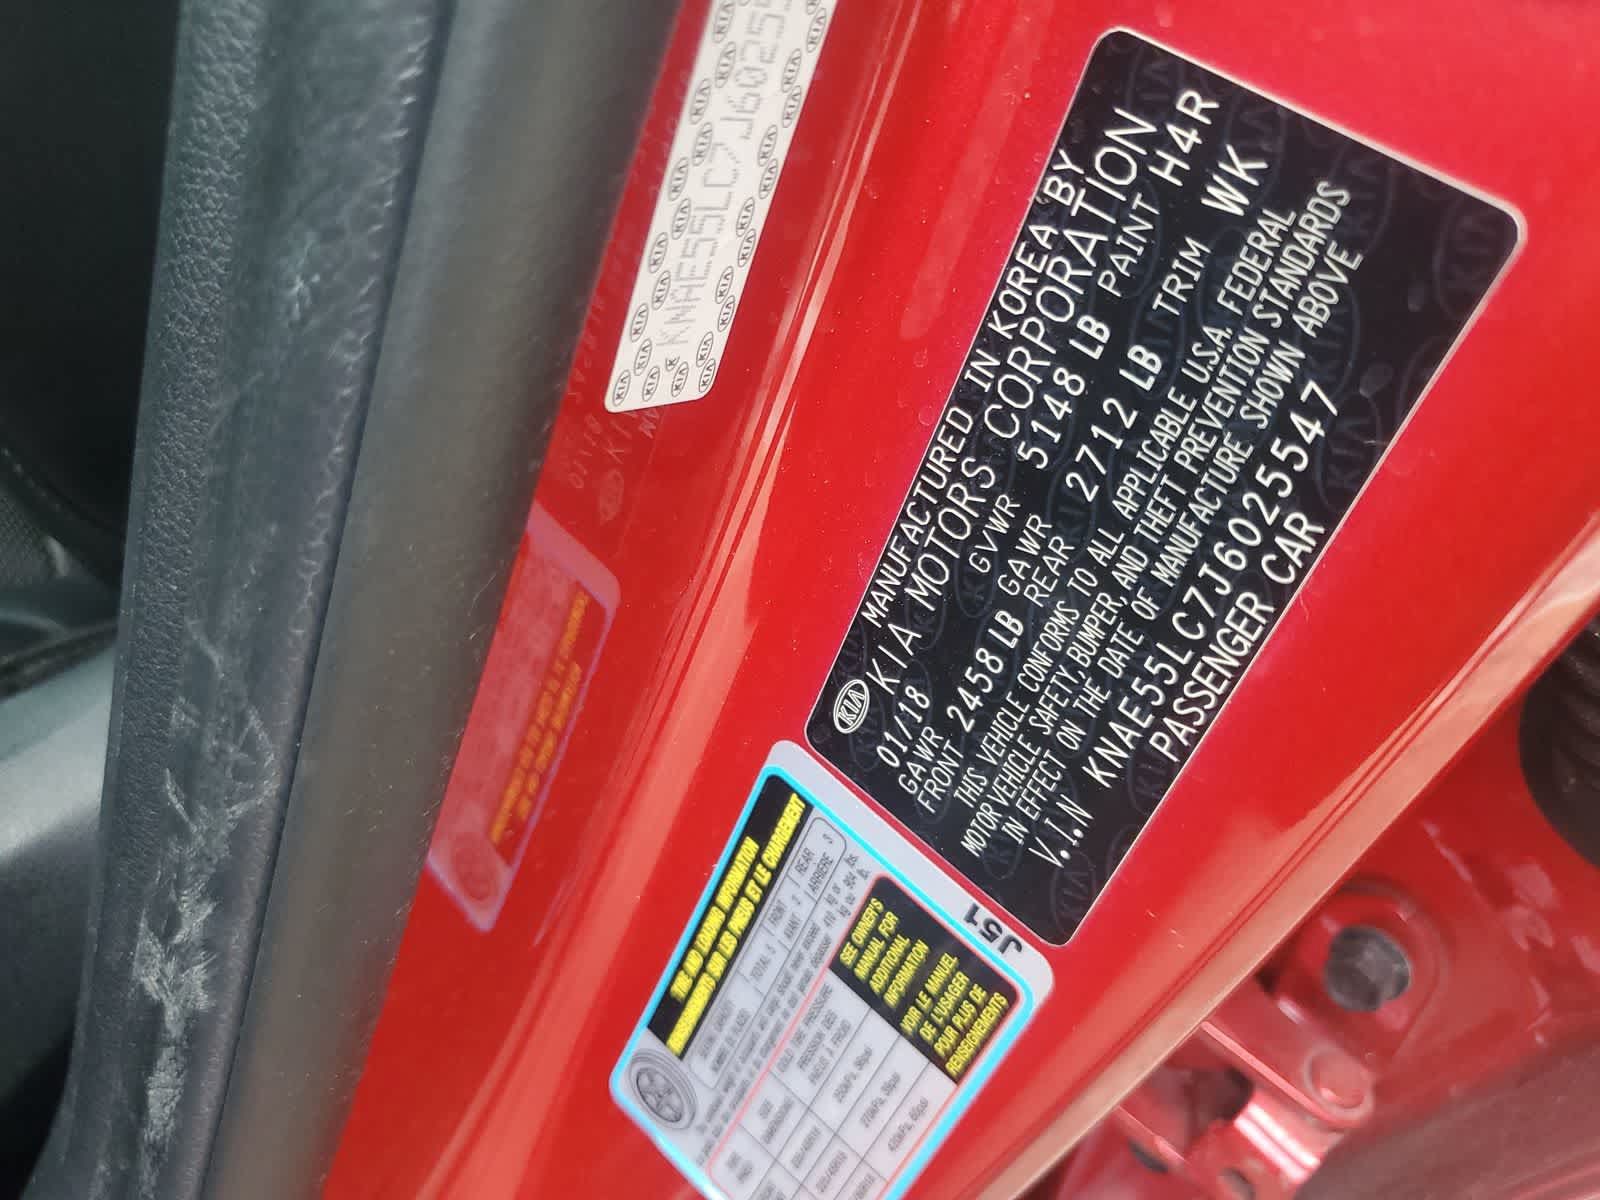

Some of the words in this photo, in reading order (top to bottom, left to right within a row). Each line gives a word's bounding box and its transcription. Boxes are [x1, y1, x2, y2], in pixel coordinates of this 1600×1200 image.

[861, 406, 973, 628] MANUFACTURED
[964, 349, 1000, 392] IN
[988, 225, 1059, 339] KOREA
[1043, 149, 1084, 206] BY
[866, 624, 922, 695] KIA
[904, 457, 995, 611] MOTORS
[984, 108, 1157, 438] CORPORATION
[1024, 536, 1074, 607] REAR
[1066, 398, 1138, 502] 2712
[1119, 345, 1162, 390] LB
[1152, 237, 1211, 315] TRIM
[1201, 144, 1268, 216] WK
[877, 685, 930, 767] 01/18
[969, 494, 1020, 573] GVWR
[1016, 367, 1085, 469] 5148
[1069, 315, 1110, 359] LB
[1098, 192, 1160, 297] PAINT
[1148, 90, 1219, 186] H4R
[953, 767, 988, 808] THIS
[976, 691, 1030, 765] VEHICLE
[1017, 600, 1080, 692] CONFORMS
[1067, 568, 1098, 596] TO
[1087, 528, 1125, 567] ALL
[1112, 386, 1197, 520] APPLICABLE
[1182, 326, 1232, 383] U.S.A.
[1217, 209, 1296, 315] FEDERAL
[961, 802, 1003, 857] MOTOR
[986, 734, 1041, 806] VEHICLE
[1029, 665, 1086, 735] SAFETY,
[1067, 593, 1128, 667] BUMPER,
[1112, 546, 1148, 590] AND
[1134, 474, 1186, 543] THEFT
[1174, 326, 1270, 474] PREVENTION
[1253, 181, 1350, 328] STANDARDS
[1002, 816, 1029, 845] IN
[1016, 749, 1066, 820] EFFECT
[1056, 719, 1086, 750] ON
[1072, 677, 1111, 718] THE
[1097, 622, 1144, 678] DATE
[1131, 586, 1160, 620] OF
[1150, 432, 1254, 587] MANUFACTURE
[1240, 340, 1305, 429] SHOWN
[1292, 240, 1363, 337] ABOVE
[998, 513, 1052, 595] GAWR
[1028, 794, 1093, 867] V.I.N
[1082, 380, 1337, 788] KNAE55LC7J6025547
[1149, 592, 1275, 762] PASSENGER
[1261, 512, 1325, 584] CAR
[917, 739, 963, 813] FRONT
[947, 648, 1003, 732] 2458
[989, 611, 1023, 648] LB
[899, 726, 943, 794] GAWR
[762, 794, 804, 870] CHARGEMENT
[795, 847, 814, 875] REAR
[682, 948, 704, 979] AND
[695, 906, 725, 956] LOADING
[715, 838, 758, 914] INFORMATION
[744, 880, 761, 903] ET
[754, 864, 771, 887] LE
[717, 931, 736, 959] LES
[727, 897, 754, 937] PNEUS
[767, 899, 786, 926] FRONT
[841, 945, 856, 966] SEE
[853, 901, 881, 946] OWNER'S
[855, 940, 883, 979] MANUAL
[879, 913, 896, 936] FOR
[962, 902, 1023, 954] J51
[706, 951, 726, 981] SUR
[871, 937, 908, 993] ADDITIONAL
[885, 942, 927, 1005] INFORMATION
[902, 1008, 920, 1031] VOIR
[918, 993, 931, 1011] LE
[926, 955, 956, 995] MANUEL
[920, 1022, 935, 1042] DE
[935, 972, 967, 1024] L'USAGER
[934, 1027, 957, 1057] POUR
[952, 1003, 975, 1030] PLUS
[969, 987, 985, 1005] DE
[946, 994, 1007, 1076] RENSEIGNEMENTS
